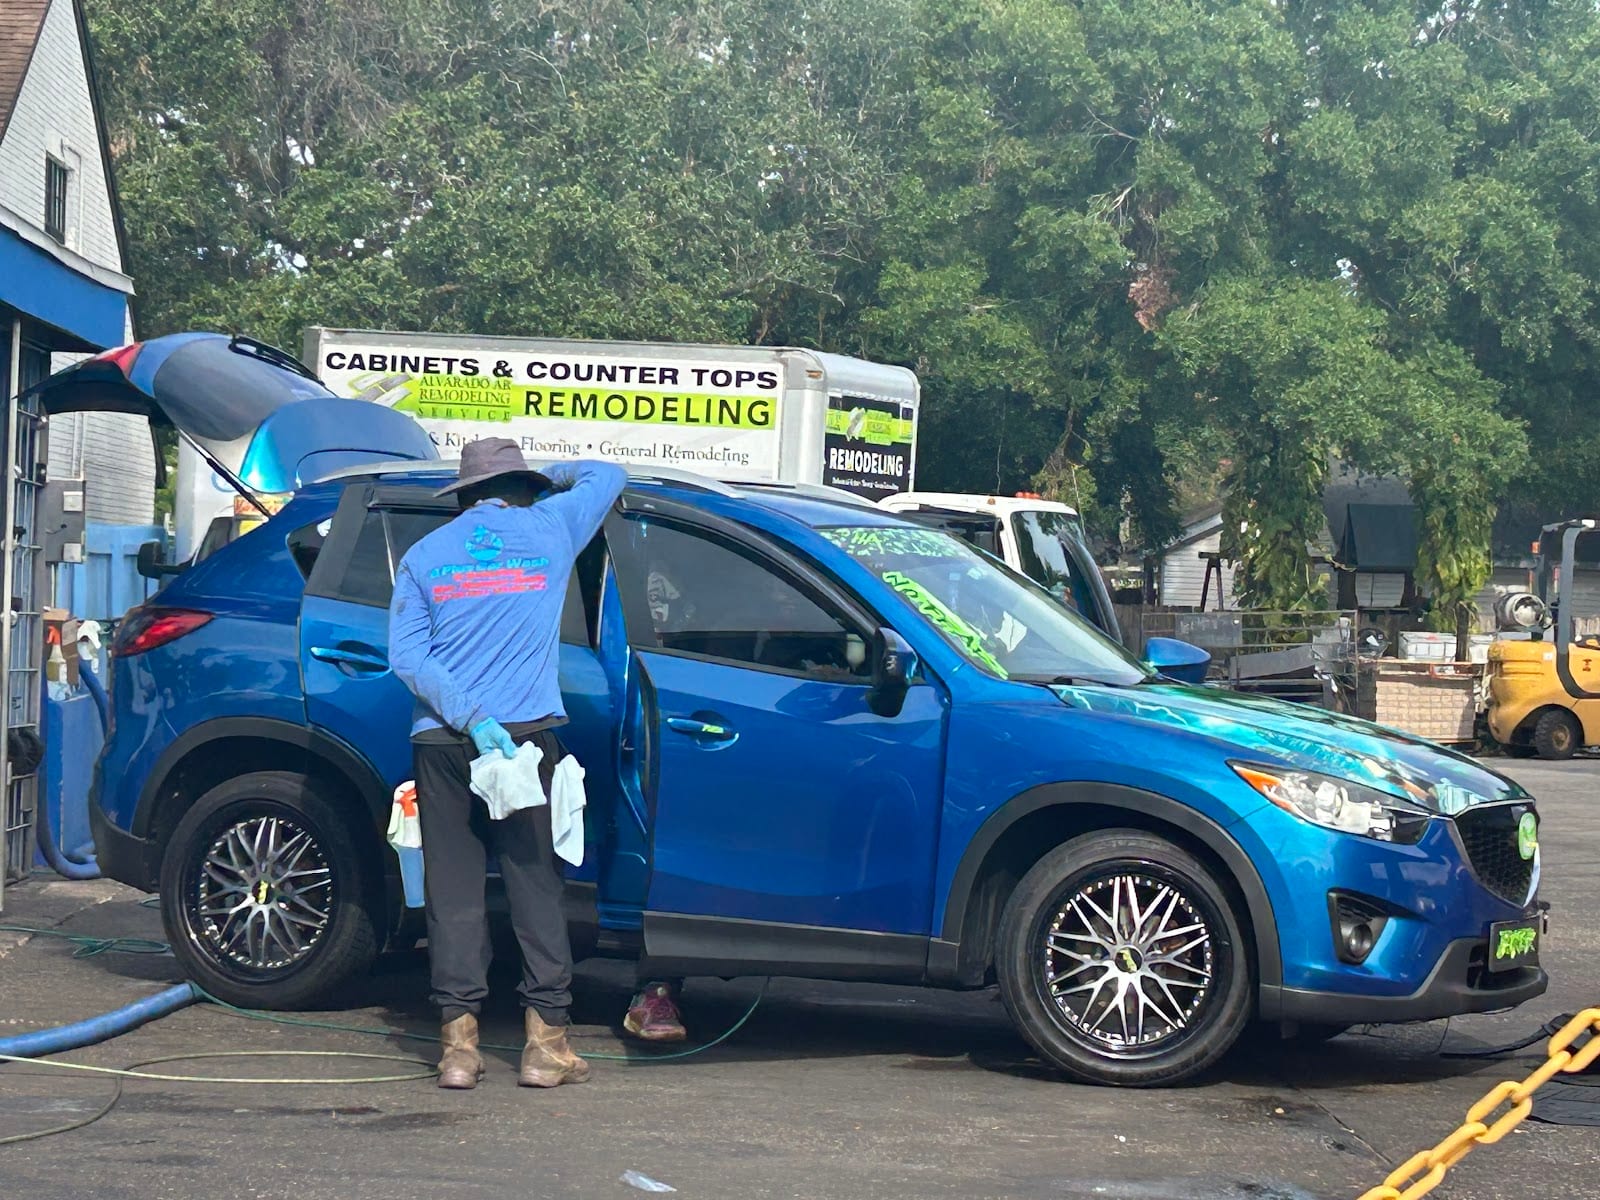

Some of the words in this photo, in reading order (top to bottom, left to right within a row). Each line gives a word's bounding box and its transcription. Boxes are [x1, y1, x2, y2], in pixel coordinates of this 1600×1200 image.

[326, 352, 480, 376] CABINETS
[492, 360, 513, 378] &
[526, 361, 679, 385] COUNTER
[692, 368, 778, 390] TOPS
[419, 389, 511, 404] REMODELING
[525, 391, 769, 426] REMODELING
[417, 407, 511, 421] SERVICE
[521, 437, 580, 455] Flooring
[600, 441, 657, 459] General
[662, 443, 749, 466] Remodeling
[829, 447, 904, 477] REMODELING
